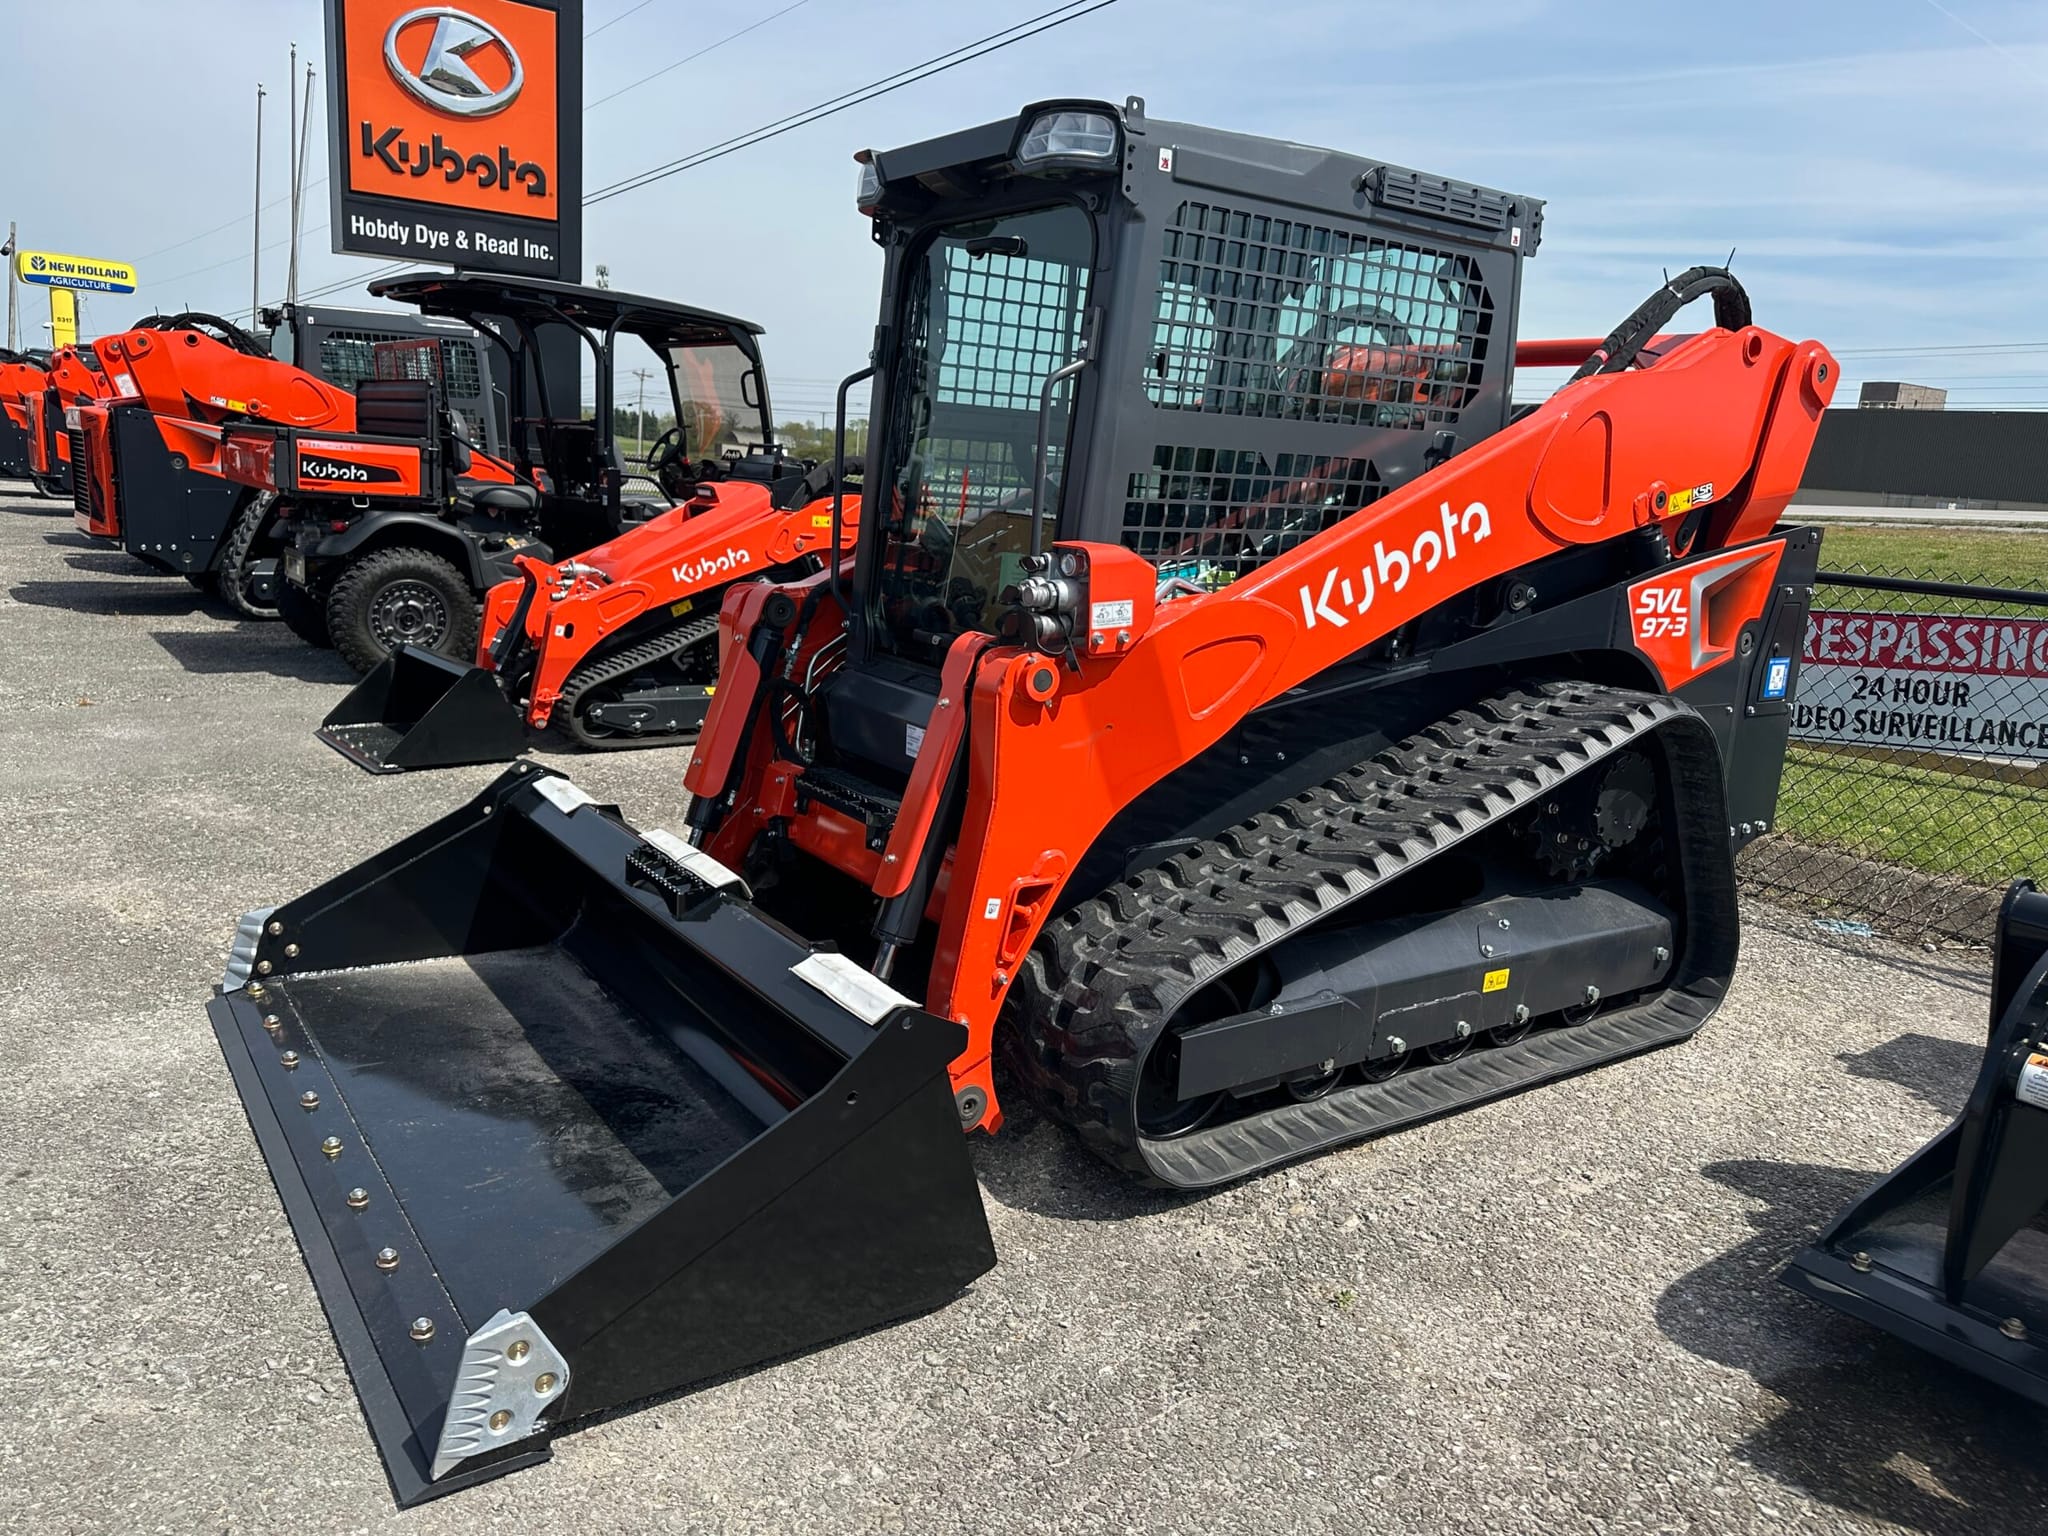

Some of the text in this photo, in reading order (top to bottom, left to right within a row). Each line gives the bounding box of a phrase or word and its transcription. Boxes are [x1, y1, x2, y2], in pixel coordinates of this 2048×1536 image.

[361, 120, 547, 197] Kubota
[351, 215, 554, 261] Hobdy Dye & Read Inc.
[49, 261, 128, 280] NEW HOLLAND
[49, 276, 111, 290] AGRICULTURE
[303, 461, 367, 480] Kubota
[1693, 483, 1713, 497] KSR
[672, 547, 750, 584] Kubota
[1299, 501, 1492, 630] Kubota
[1635, 588, 1688, 614] SVL
[1639, 617, 1688, 638] 97-3
[1802, 616, 2048, 672] RESPASSING
[1852, 675, 1970, 707] 24 HOUR
[1790, 704, 2048, 749] IDEO SURVEILLANCE
